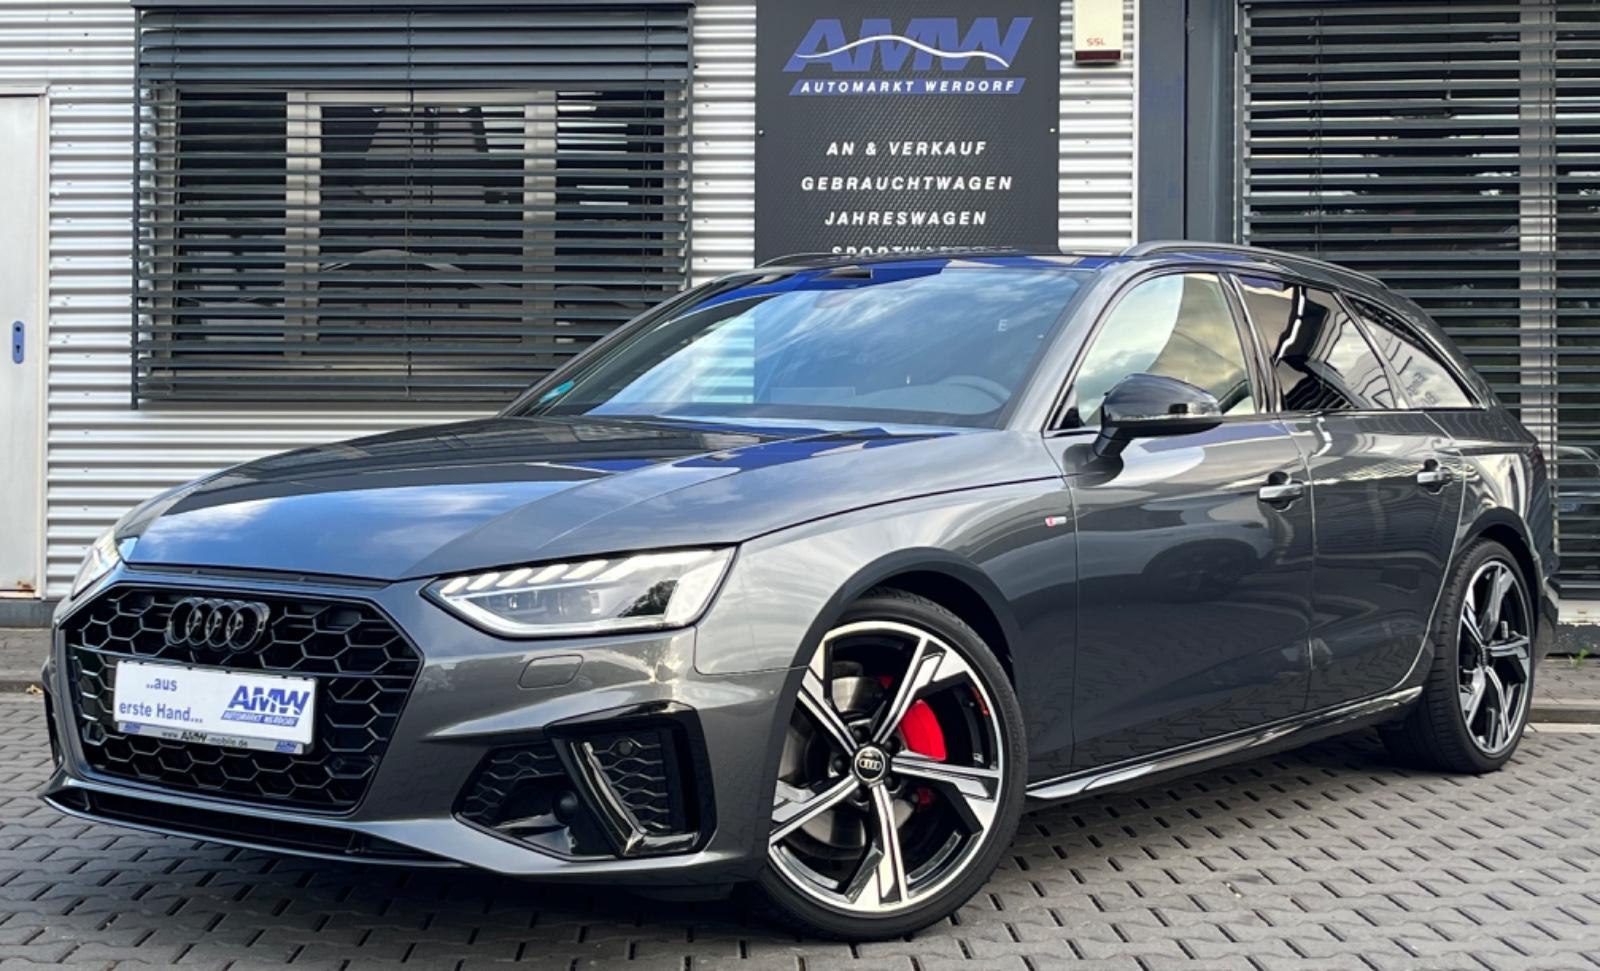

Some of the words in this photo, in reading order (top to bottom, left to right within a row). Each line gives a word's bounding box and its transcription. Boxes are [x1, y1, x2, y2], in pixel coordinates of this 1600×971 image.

[783, 17, 1033, 72] AMW
[800, 80, 914, 93] AUTOMARKT
[925, 79, 1016, 93] WERDORF
[826, 142, 854, 156] AN
[865, 142, 877, 156] &
[888, 141, 987, 156] VERKAUF
[801, 176, 1013, 191] GEBRAUCHTWAGEN
[825, 211, 987, 226] JAHRESWAGEN
[227, 685, 310, 716] AMW
[119, 701, 152, 716] erste
